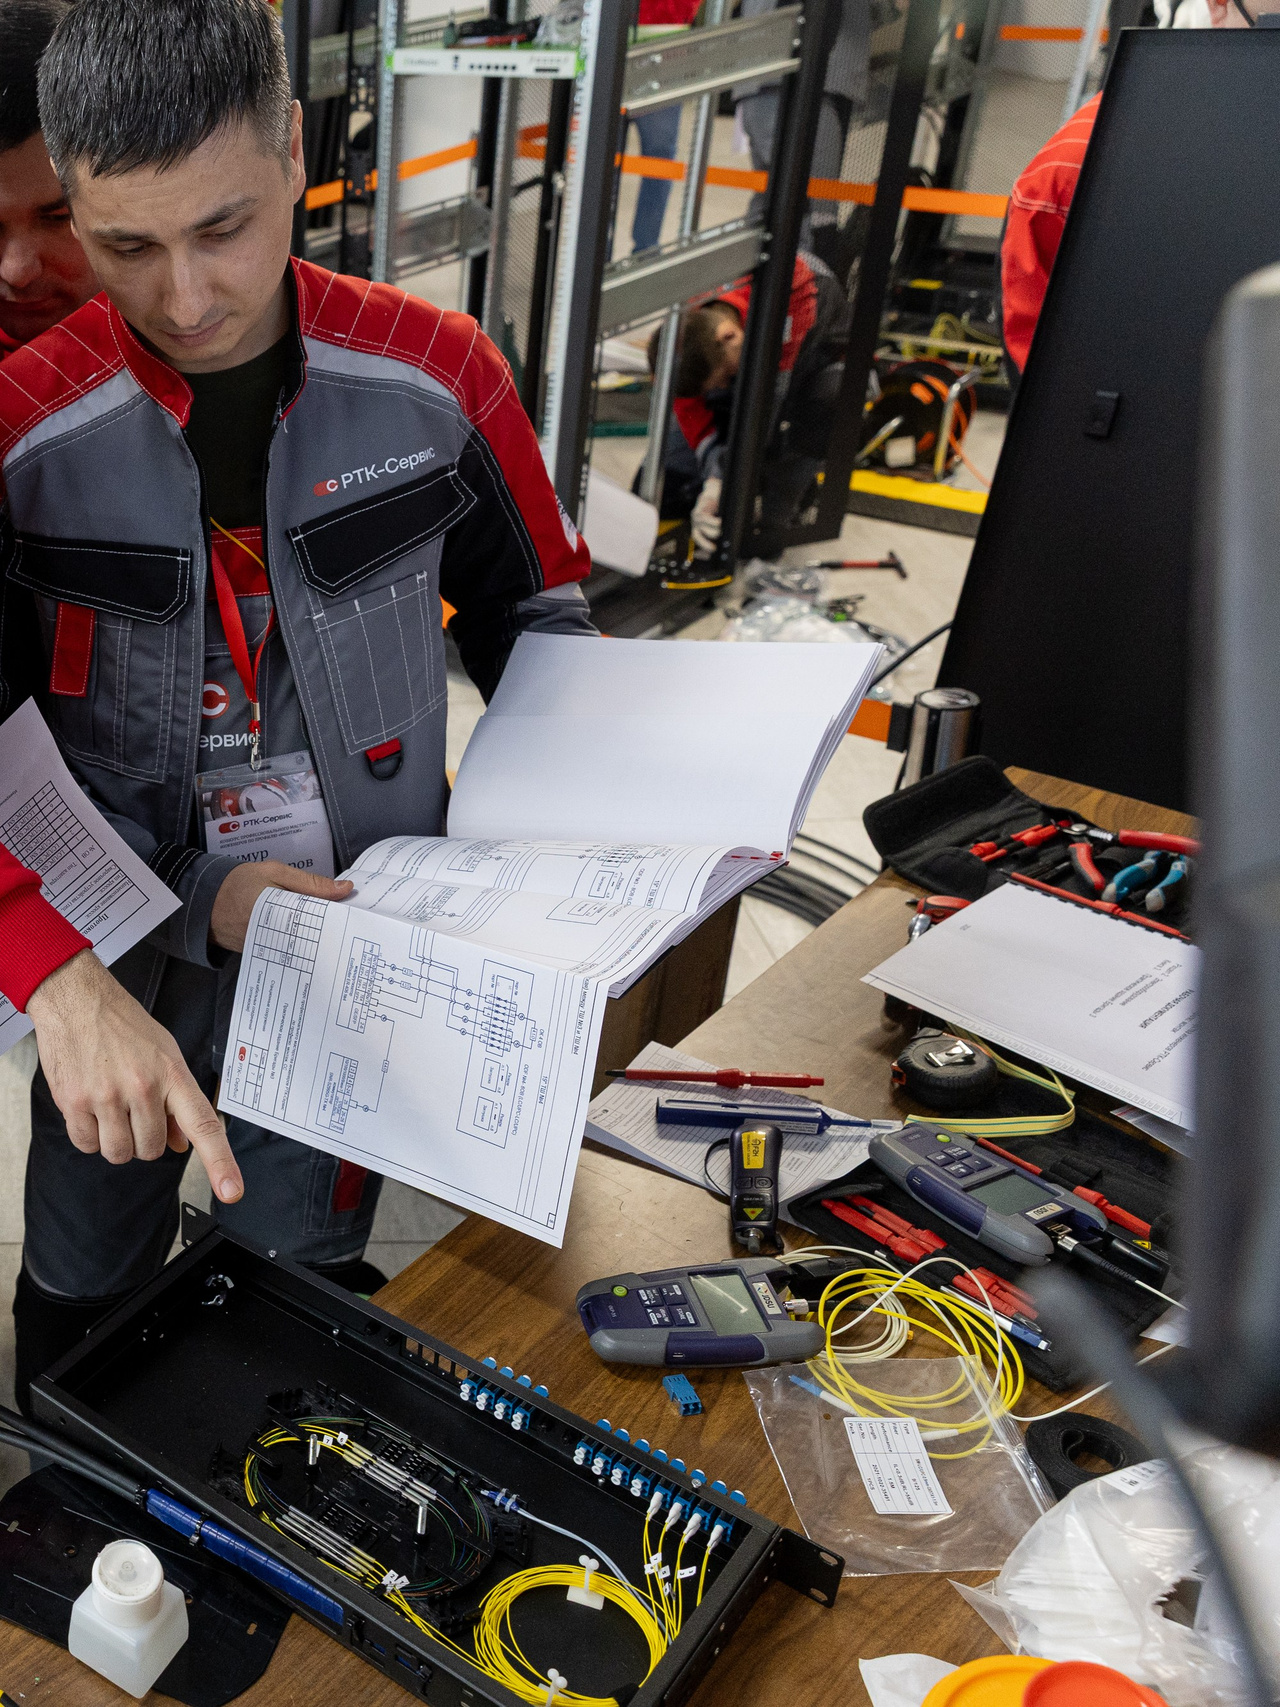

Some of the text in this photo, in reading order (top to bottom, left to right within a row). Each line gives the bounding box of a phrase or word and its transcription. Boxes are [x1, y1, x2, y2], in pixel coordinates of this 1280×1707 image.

[340, 447, 436, 489] РТК-Сервис
[199, 733, 261, 752] ервис
[242, 811, 293, 828] РТК-Сервис
[236, 849, 269, 866] мур
[47, 861, 77, 886] Тип адаптера
[91, 862, 117, 884] Сварочное
[69, 881, 95, 903] устройства
[97, 872, 123, 894] Тип кросса:
[83, 879, 131, 919] Наименование кросса:
[252, 984, 260, 1005] кабельных
[265, 979, 275, 1007] Станционные
[579, 990, 587, 1008] между
[247, 1005, 256, 1030] соединений
[278, 1002, 288, 1032] Практическое
[578, 1009, 585, 1018] ТШ
[577, 1019, 583, 1029] №3
[574, 1035, 581, 1044] ТШ
[573, 1045, 579, 1055] №4
[270, 1051, 279, 1070] Бригады
[1140, 1047, 1169, 1073] РТК-Сервис
[486, 1066, 494, 1084] Заглушка
[540, 1084, 546, 1093] ТШ
[538, 1094, 544, 1104] №4
[479, 1104, 487, 1122] Заглушка
[1031, 1206, 1048, 1217] JDSU
[761, 1293, 774, 1309] JDSU
[675, 1307, 685, 1320] STORE
[868, 1422, 877, 1439] Length
[880, 1422, 892, 1453] Performance
[891, 1422, 899, 1435] Fiber
[902, 1423, 910, 1434] Type
[866, 1477, 874, 1490] 1PCS
